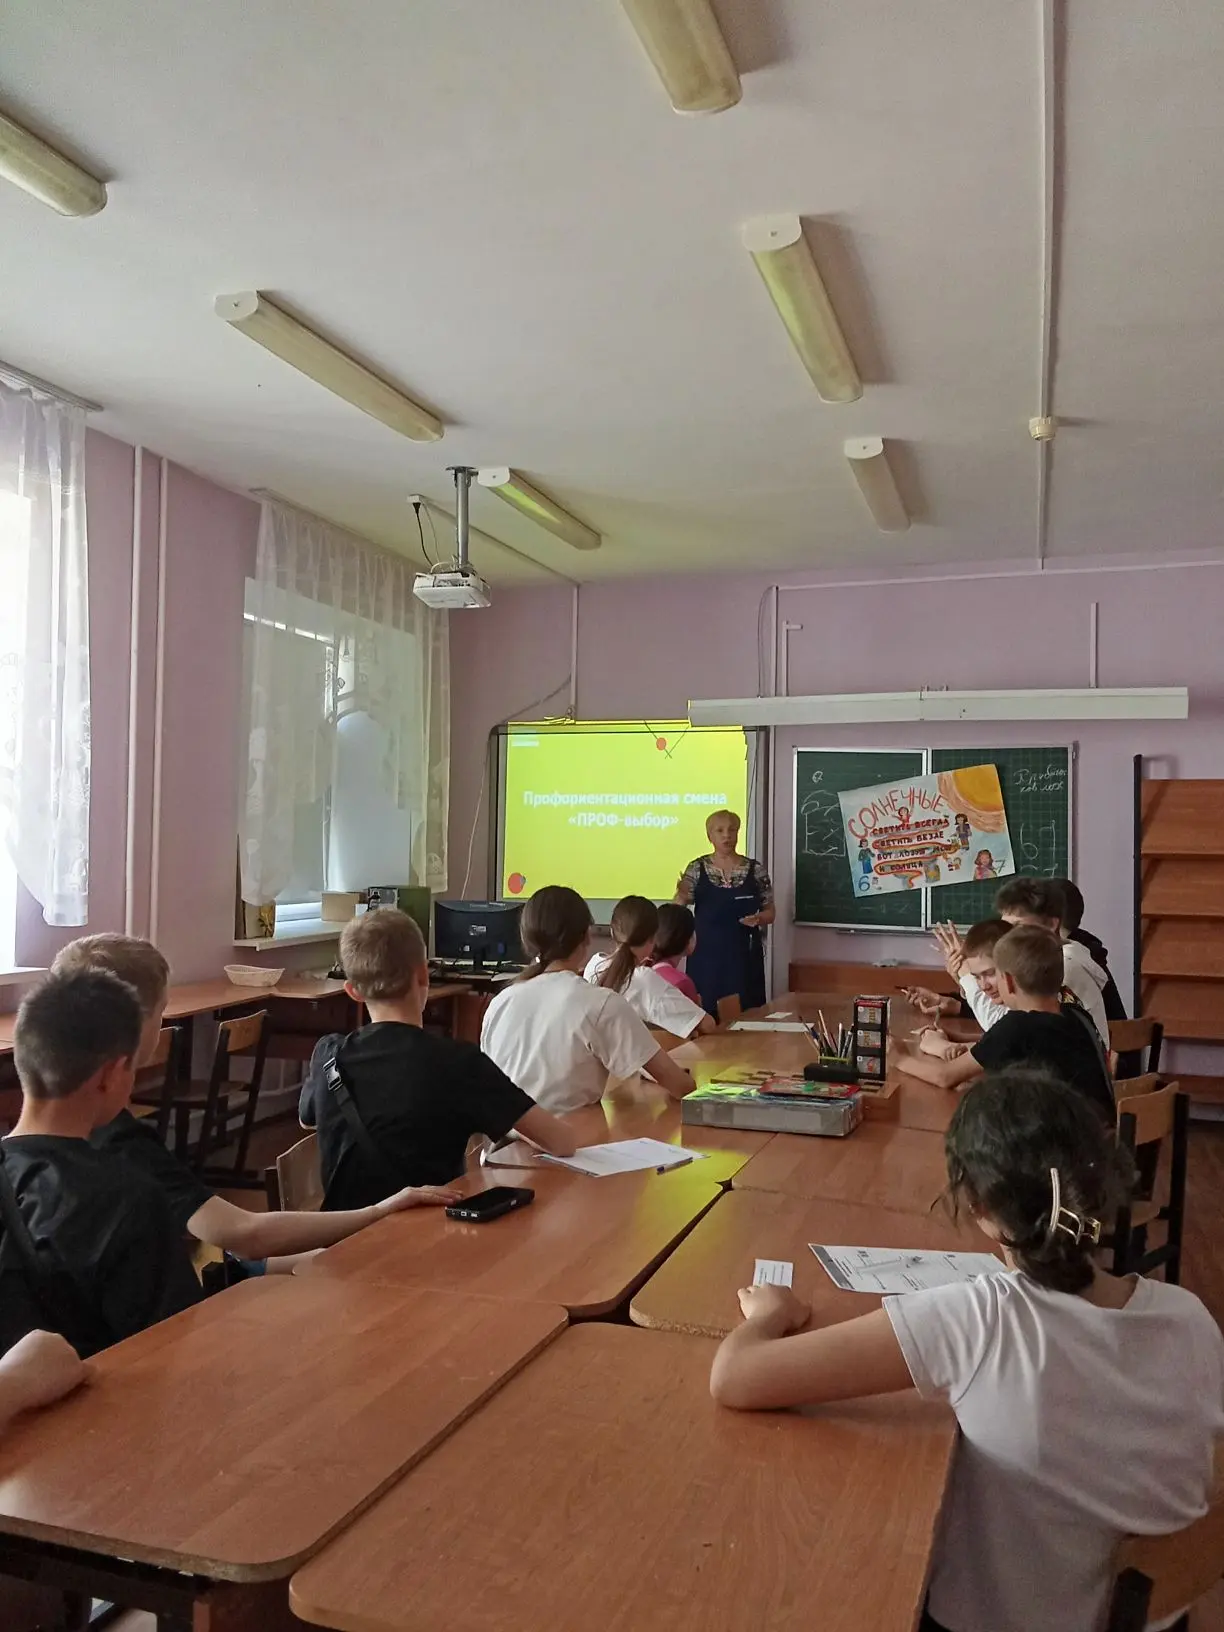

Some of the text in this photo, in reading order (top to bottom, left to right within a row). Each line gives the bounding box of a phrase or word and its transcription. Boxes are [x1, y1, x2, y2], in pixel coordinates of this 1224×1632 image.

[523, 791, 728, 807] Профориентационная смена
[848, 786, 945, 839] СОЛНЕЧНЫЕ
[916, 831, 944, 842] ВЕЗДЕ
[877, 851, 893, 861] ВОТ
[858, 875, 870, 891] 6
